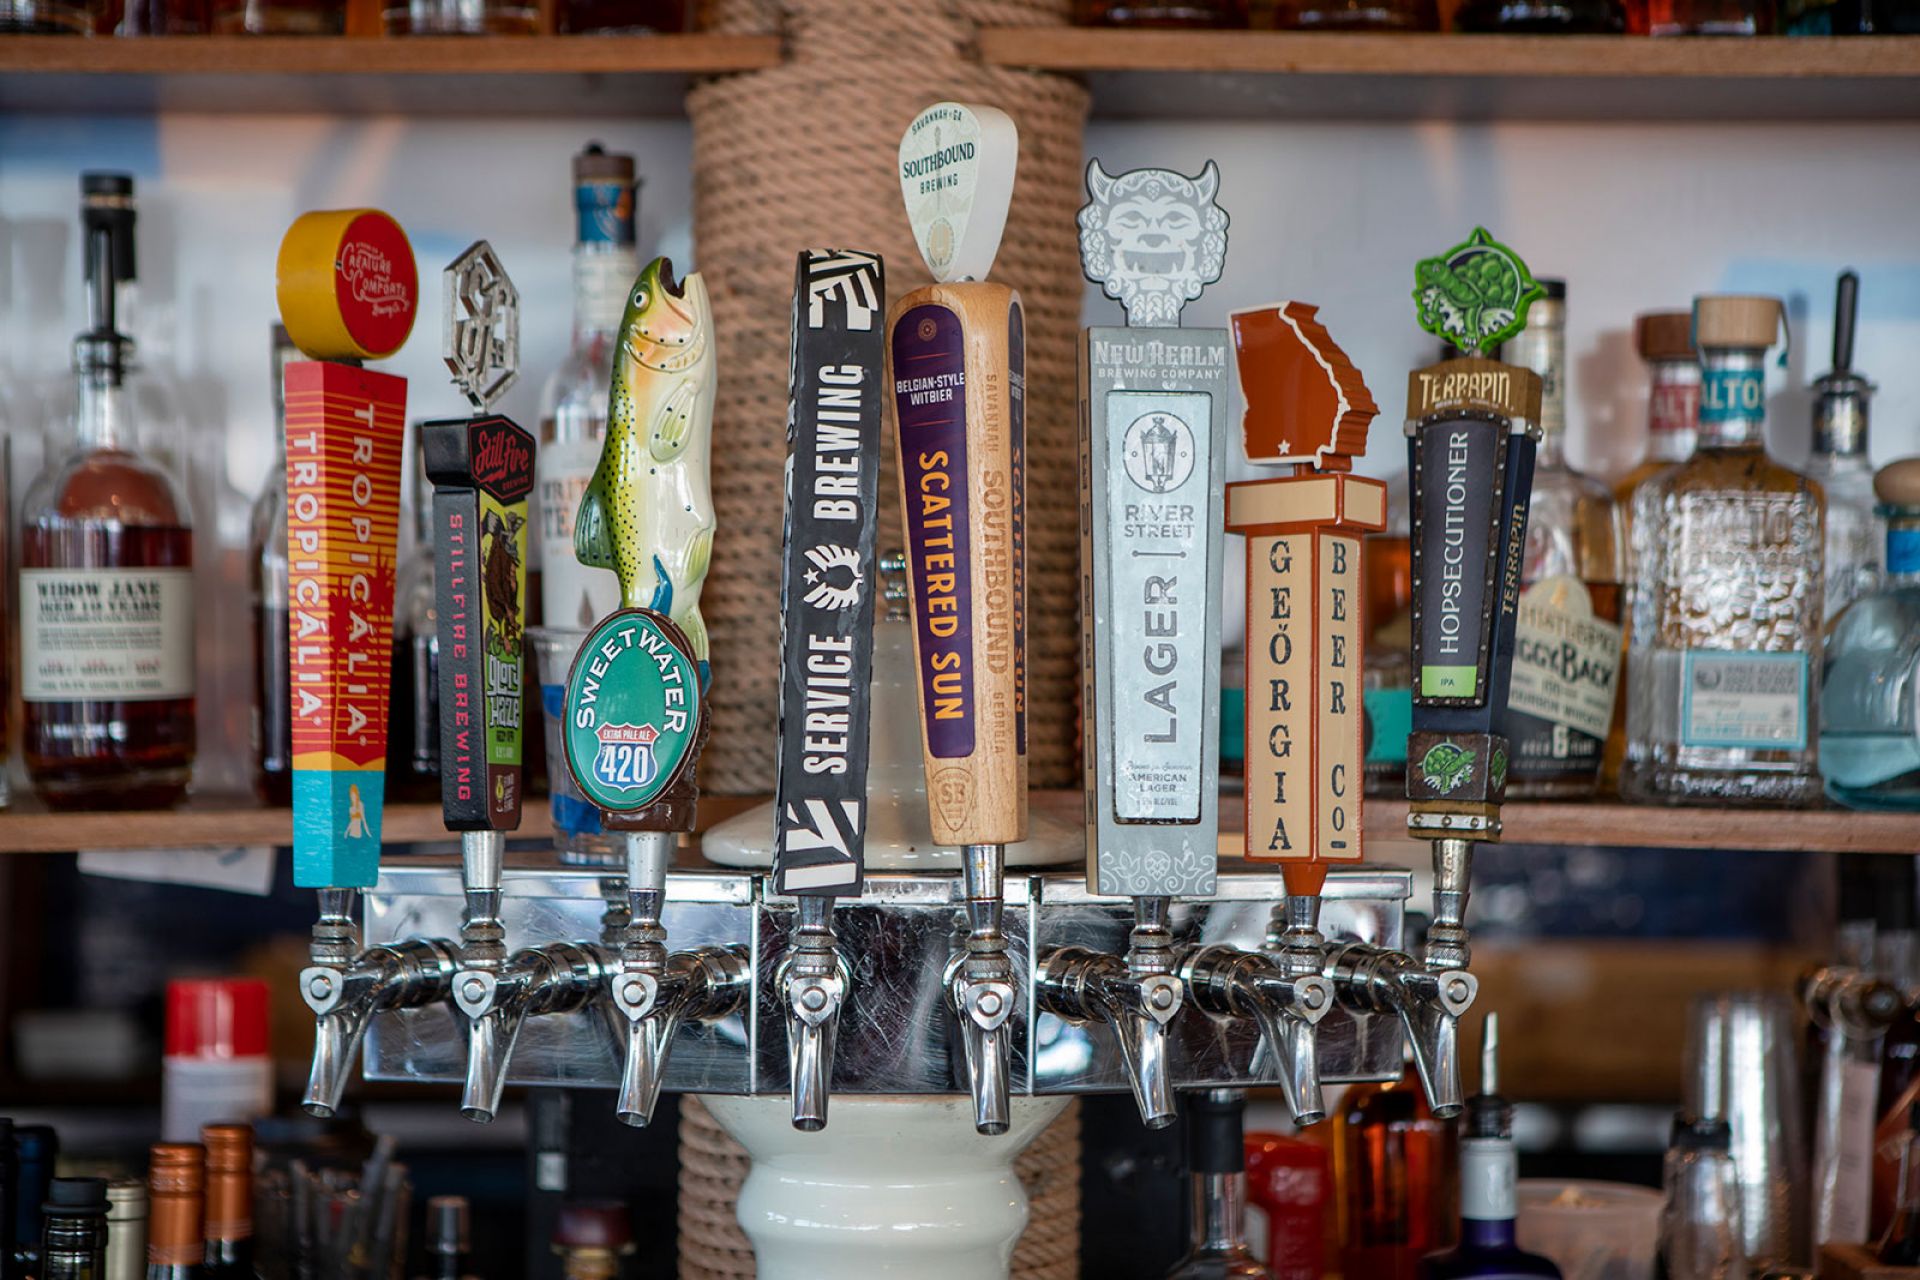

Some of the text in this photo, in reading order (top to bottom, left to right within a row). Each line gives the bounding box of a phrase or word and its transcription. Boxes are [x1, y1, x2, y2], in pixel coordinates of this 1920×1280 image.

[903, 142, 975, 179] SOUTHBOUND
[920, 173, 958, 194] BREWING
[1095, 340, 1225, 366] NEW REALM
[1098, 368, 1222, 379] BREWING COMPANY
[1419, 371, 1511, 411] TERRAPIN
[910, 388, 953, 406] WITBIER
[986, 374, 998, 452] SAVANNAH
[1124, 524, 1195, 539] STREET
[1125, 504, 1194, 522] RIVER
[1440, 431, 1469, 654] HOPSECUTIONER
[1502, 503, 1525, 615] TERRAPIN
[37, 580, 161, 597] WIDOW JANE
[803, 365, 865, 774] SERVICE BREWING
[918, 450, 964, 720] SCATTERED SUN
[983, 470, 1009, 675] SOUTHBOUND
[1011, 447, 1024, 713] SCATTERED SUN
[1330, 542, 1347, 715] BEER
[449, 513, 471, 801] STILLFIRE BREWING
[1143, 576, 1178, 744] LAGER
[575, 627, 688, 734] SWEETWATER
[1268, 541, 1293, 851] GEORGIA
[1440, 678, 1455, 687] IPA
[603, 728, 651, 741] EXTRA PALE ALE
[991, 691, 1007, 755] GEORGIA
[600, 745, 649, 783] 420
[1128, 773, 1188, 782] AMERICAN
[1140, 783, 1177, 793] LAGER
